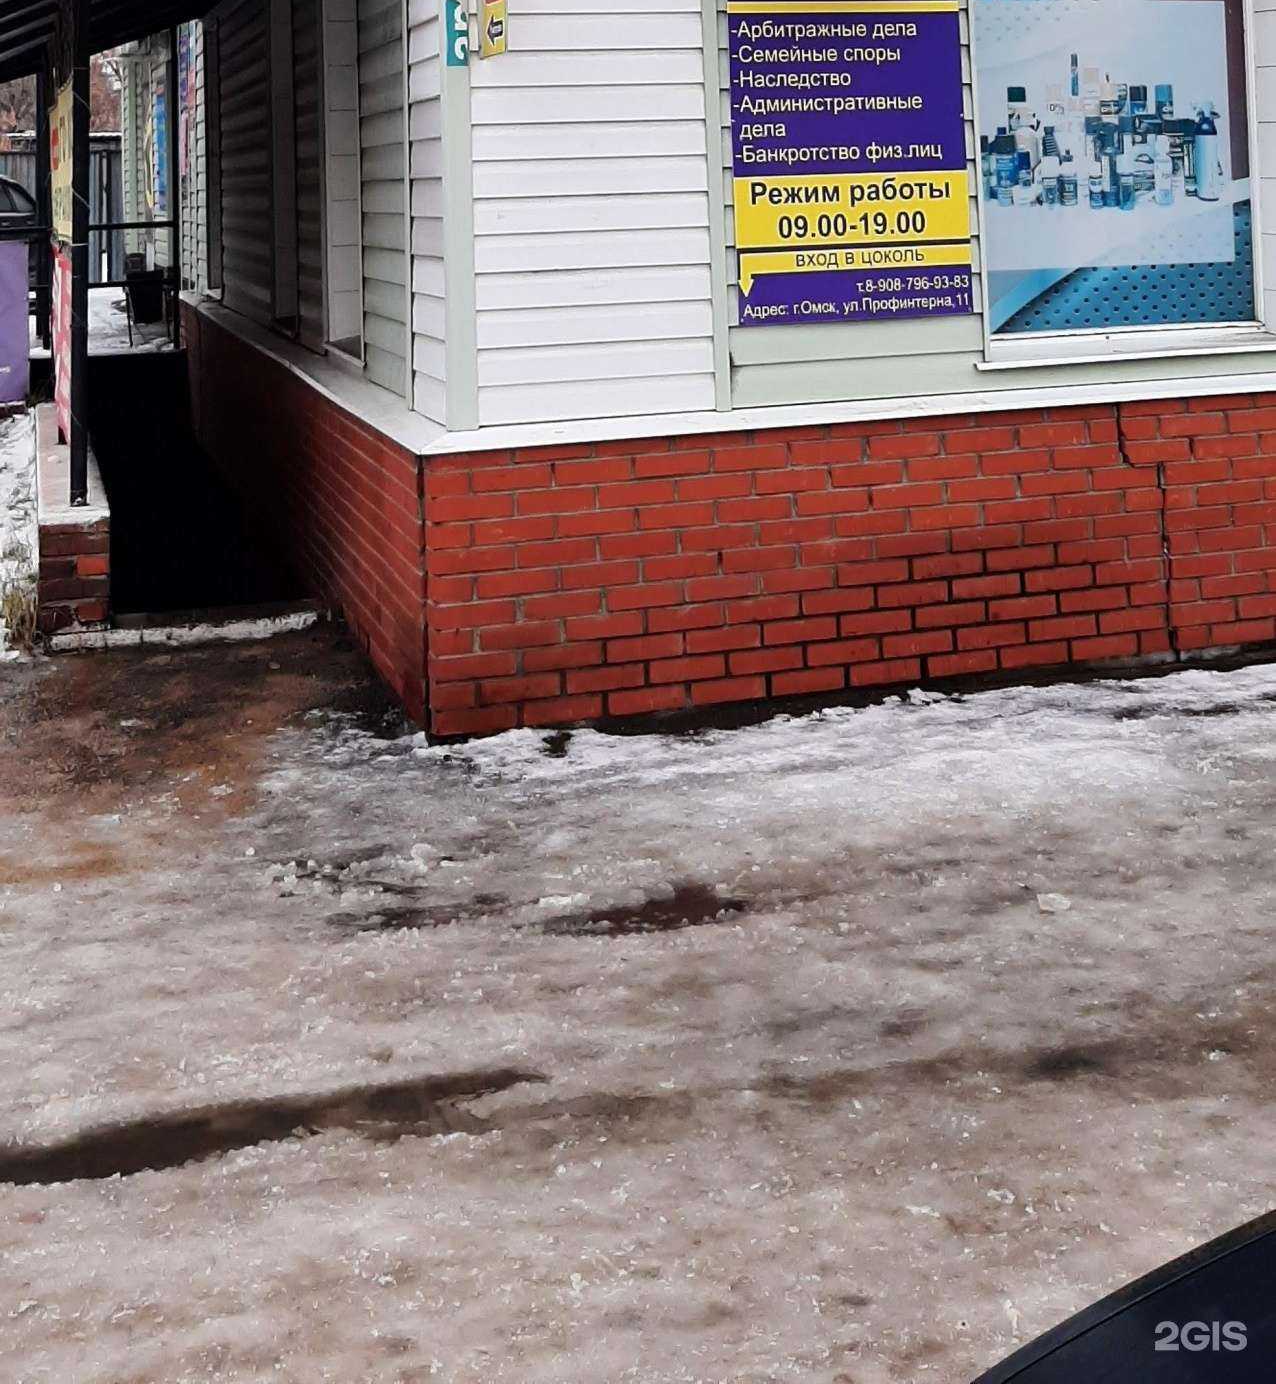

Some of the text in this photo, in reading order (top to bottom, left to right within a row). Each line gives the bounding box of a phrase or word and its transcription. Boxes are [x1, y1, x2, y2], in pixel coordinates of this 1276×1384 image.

[731, 20, 917, 41] -Арбитражные дела
[731, 45, 901, 66] -Семейные споры
[733, 70, 851, 89] -Наследство
[733, 95, 923, 115] -Административные
[739, 122, 786, 140] дела
[735, 142, 943, 165] -Банкротство физ.лиц
[750, 177, 950, 207] Режим работы
[778, 210, 926, 239] 09.00-19.00
[743, 303, 789, 319] Адрес:
